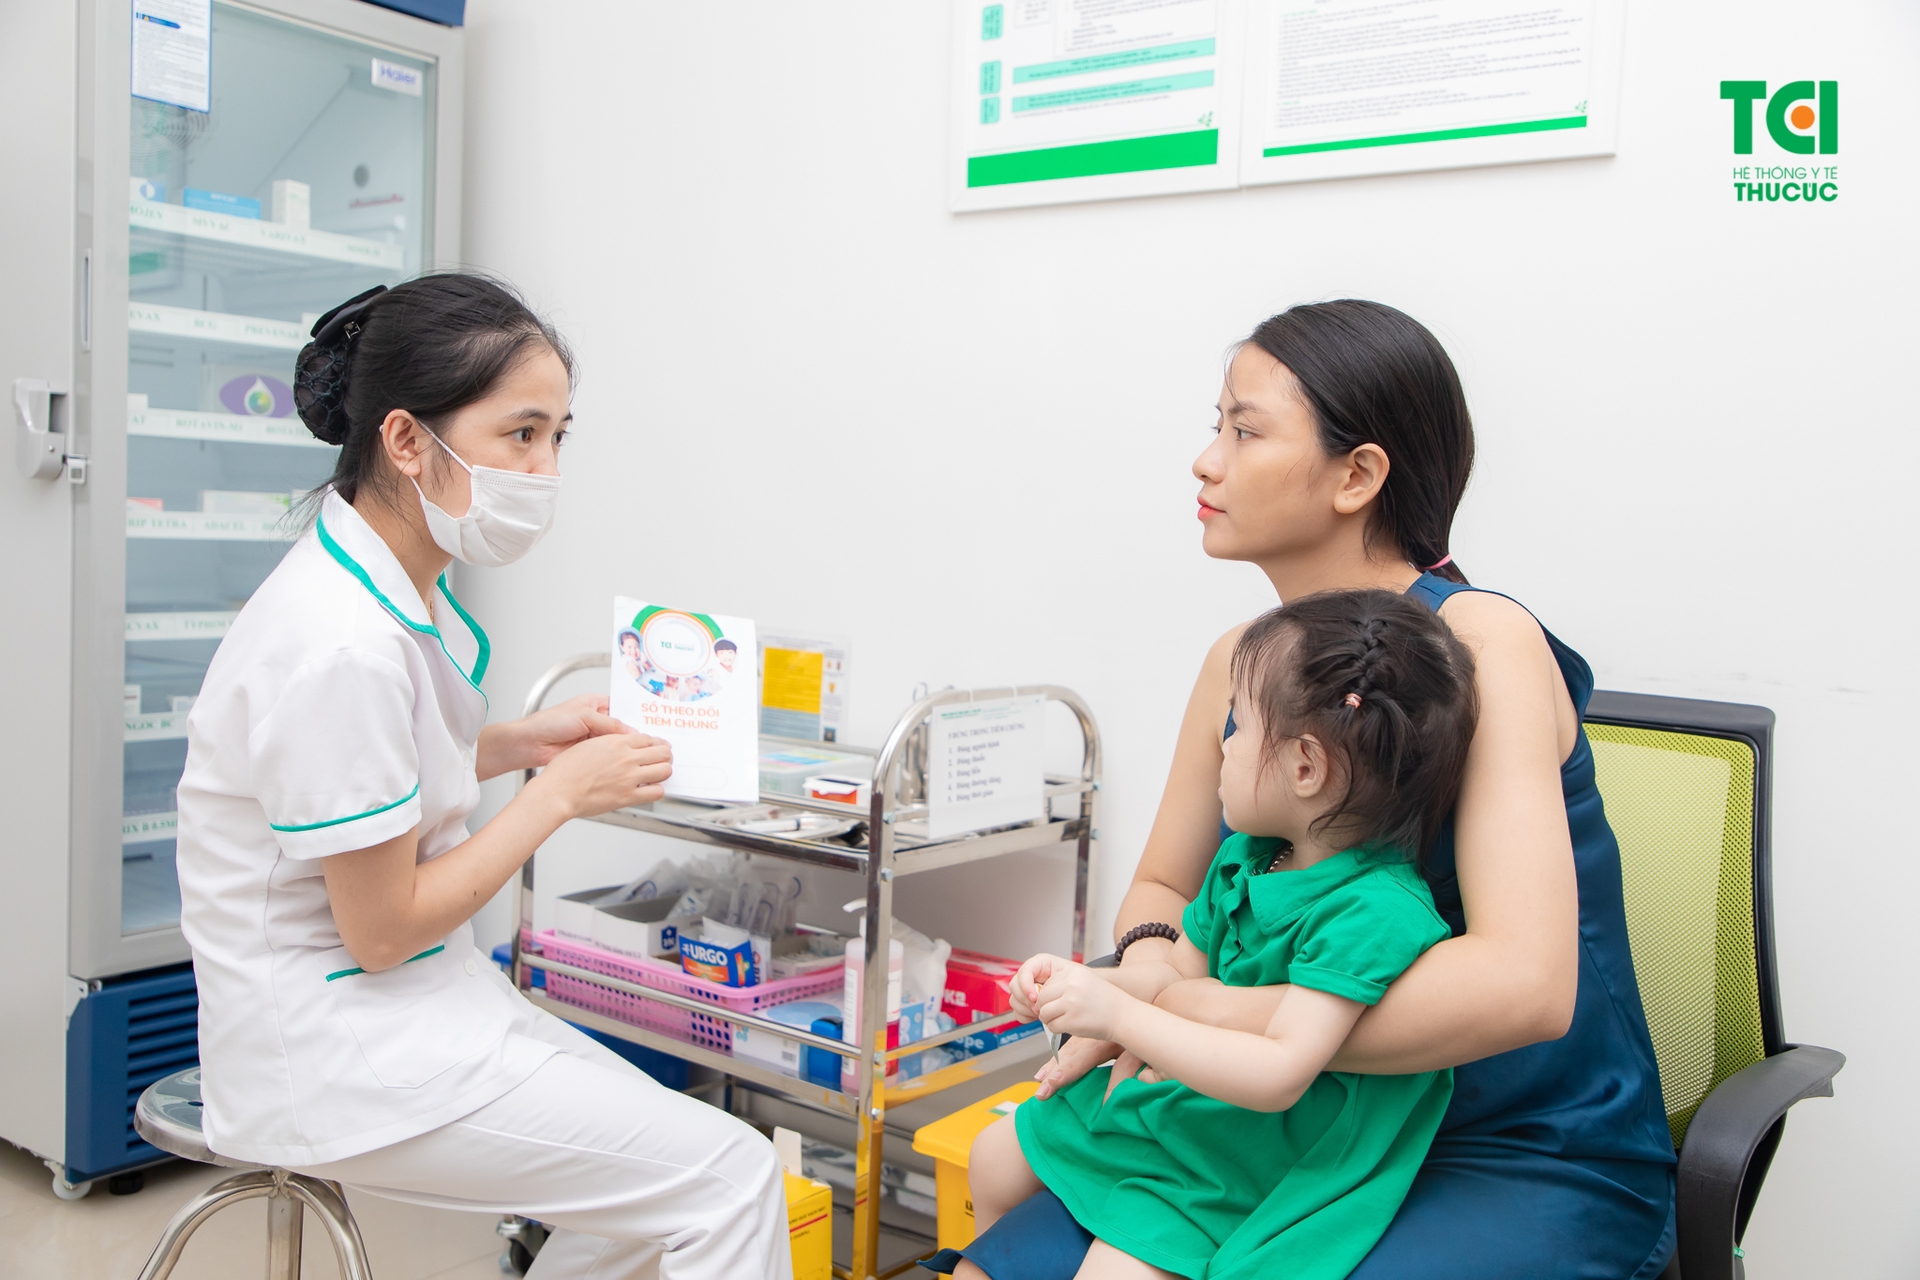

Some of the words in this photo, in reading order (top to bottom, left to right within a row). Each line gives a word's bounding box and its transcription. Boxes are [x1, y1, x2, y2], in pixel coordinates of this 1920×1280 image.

[661, 704, 694, 716] THEO
[643, 714, 671, 727] TIÊM
[689, 943, 728, 966] URGO
